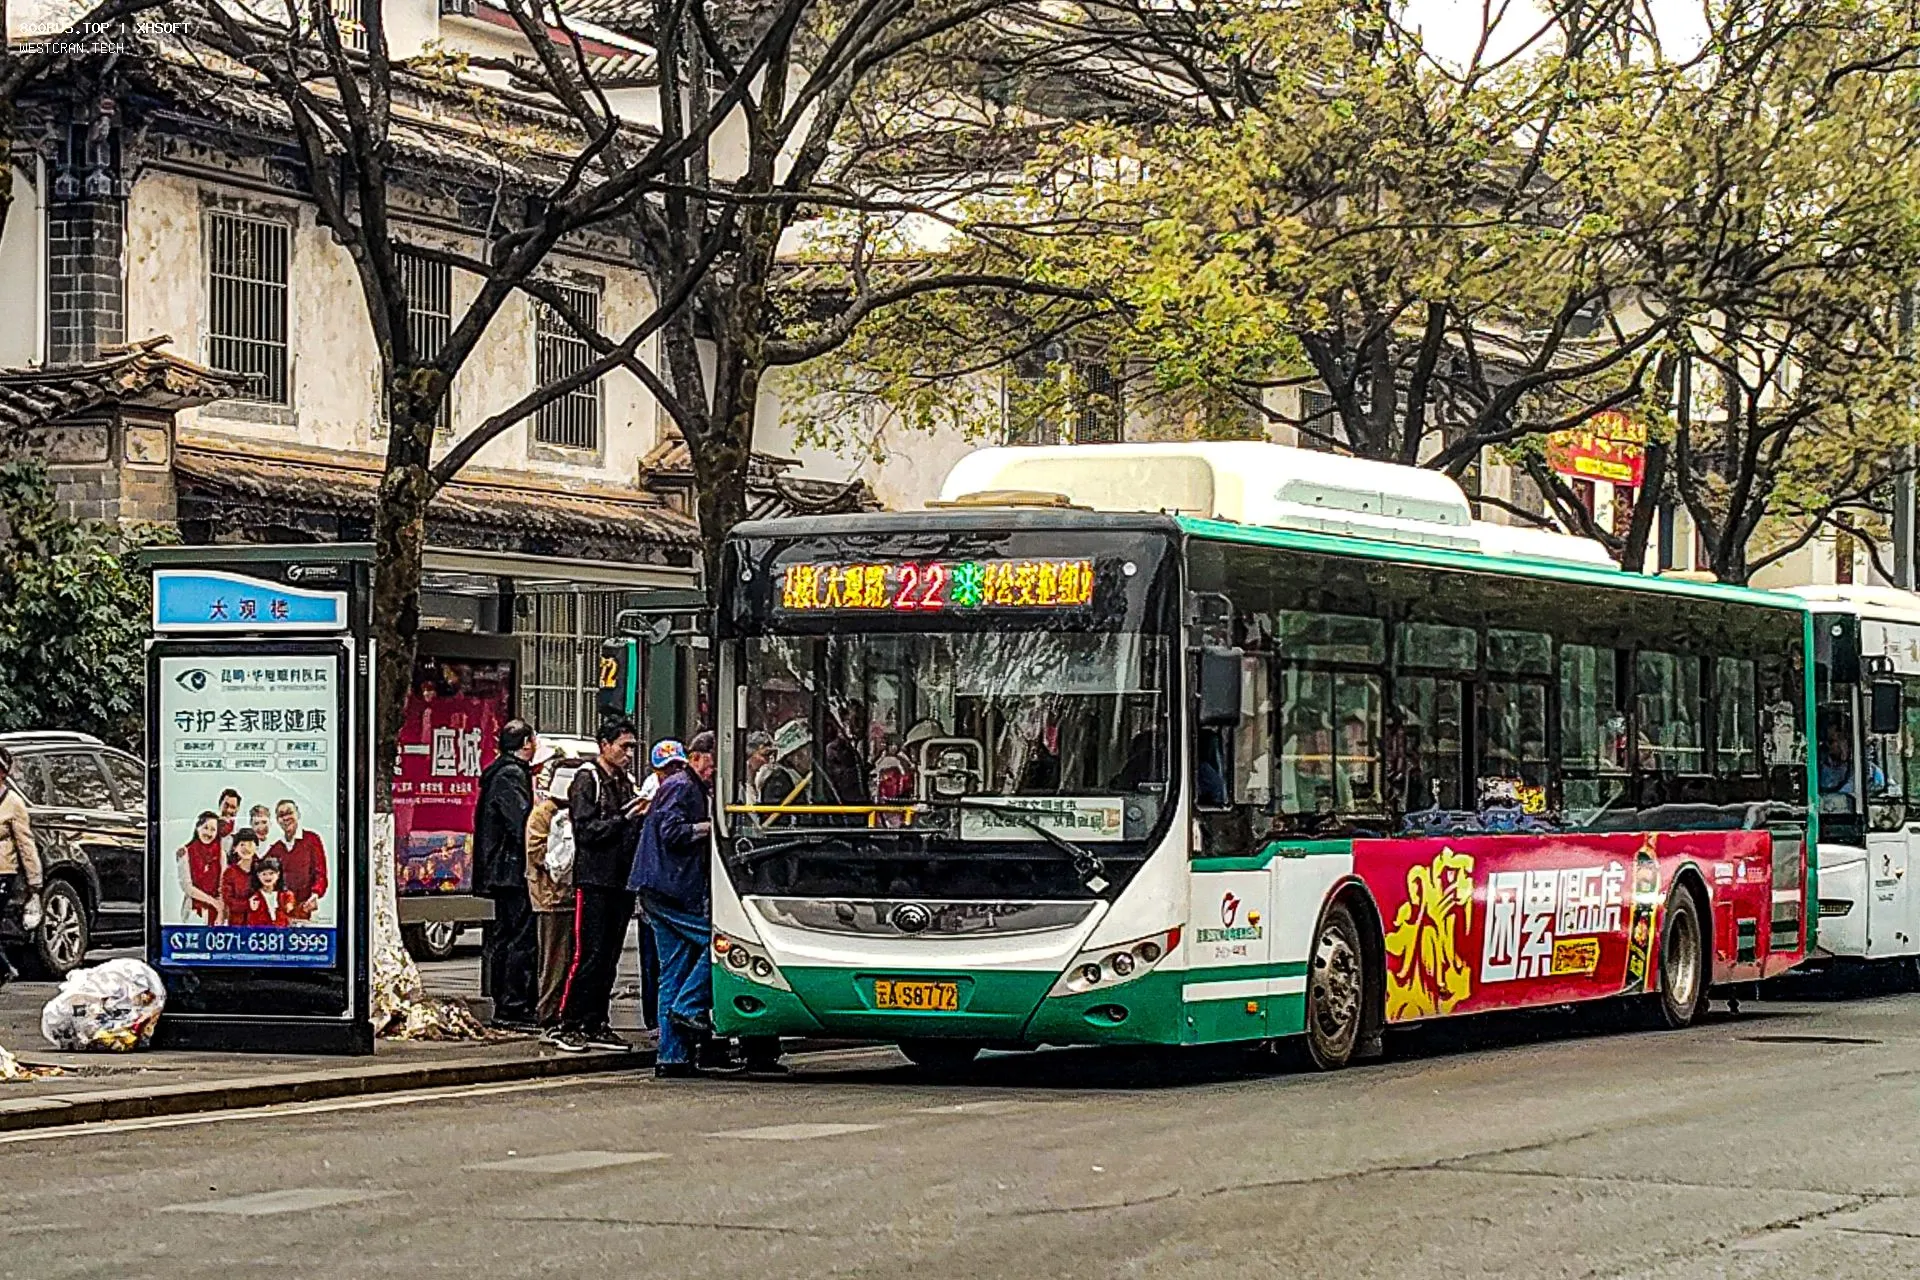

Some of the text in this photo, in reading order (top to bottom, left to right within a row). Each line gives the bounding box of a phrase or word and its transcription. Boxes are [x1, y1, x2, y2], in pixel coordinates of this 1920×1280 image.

[893, 561, 945, 610] 22
[208, 597, 290, 620] 大观楼
[174, 708, 327, 733] 守护全家眼健康
[205, 931, 285, 952] 0871-6381
[288, 933, 328, 952] 9999
